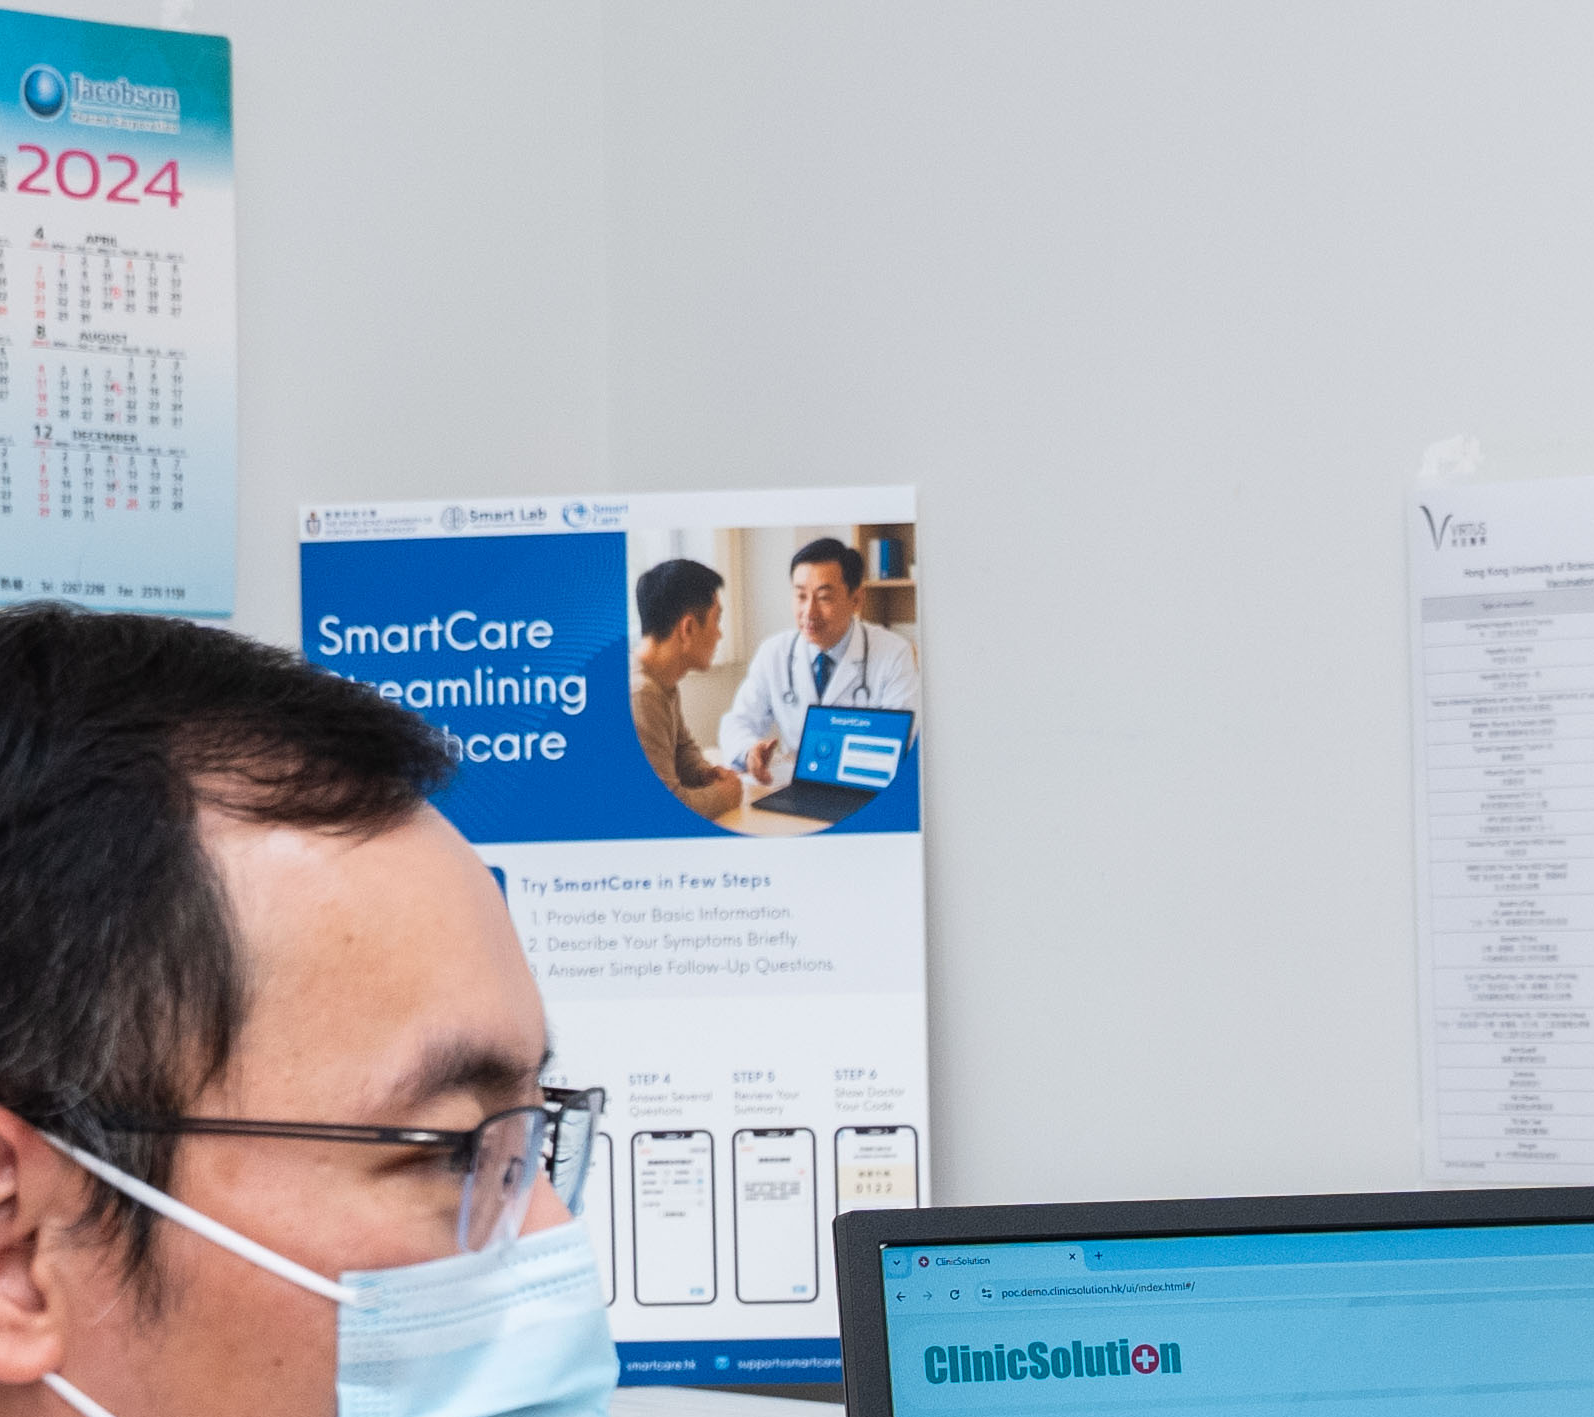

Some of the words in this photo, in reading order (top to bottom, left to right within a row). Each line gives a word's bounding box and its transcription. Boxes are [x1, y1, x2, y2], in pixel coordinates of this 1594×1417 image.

[71, 72, 177, 110] Jacobson
[17, 143, 183, 208] 2024
[469, 509, 515, 522] Smart
[520, 507, 548, 521] Lab
[319, 610, 553, 655] SmartCare
[324, 665, 587, 715] eamlining
[521, 879, 547, 896] Try
[554, 877, 652, 892] SmartCare
[658, 876, 673, 889] in
[680, 874, 716, 889] Few
[723, 873, 771, 891] Steps
[547, 909, 606, 925] Provide
[613, 909, 647, 923] Your
[652, 909, 695, 922] Basic
[548, 937, 617, 952] Describe
[623, 936, 658, 949] Your
[664, 935, 742, 952] Symptoms
[548, 964, 604, 978] Answer
[610, 962, 662, 978] Simple
[668, 959, 750, 977] Follow-Up
[629, 1074, 658, 1085] STEP
[734, 1072, 763, 1083] STEP
[835, 1070, 864, 1081] STEP
[935, 1255, 990, 1267] ClinicSolution
